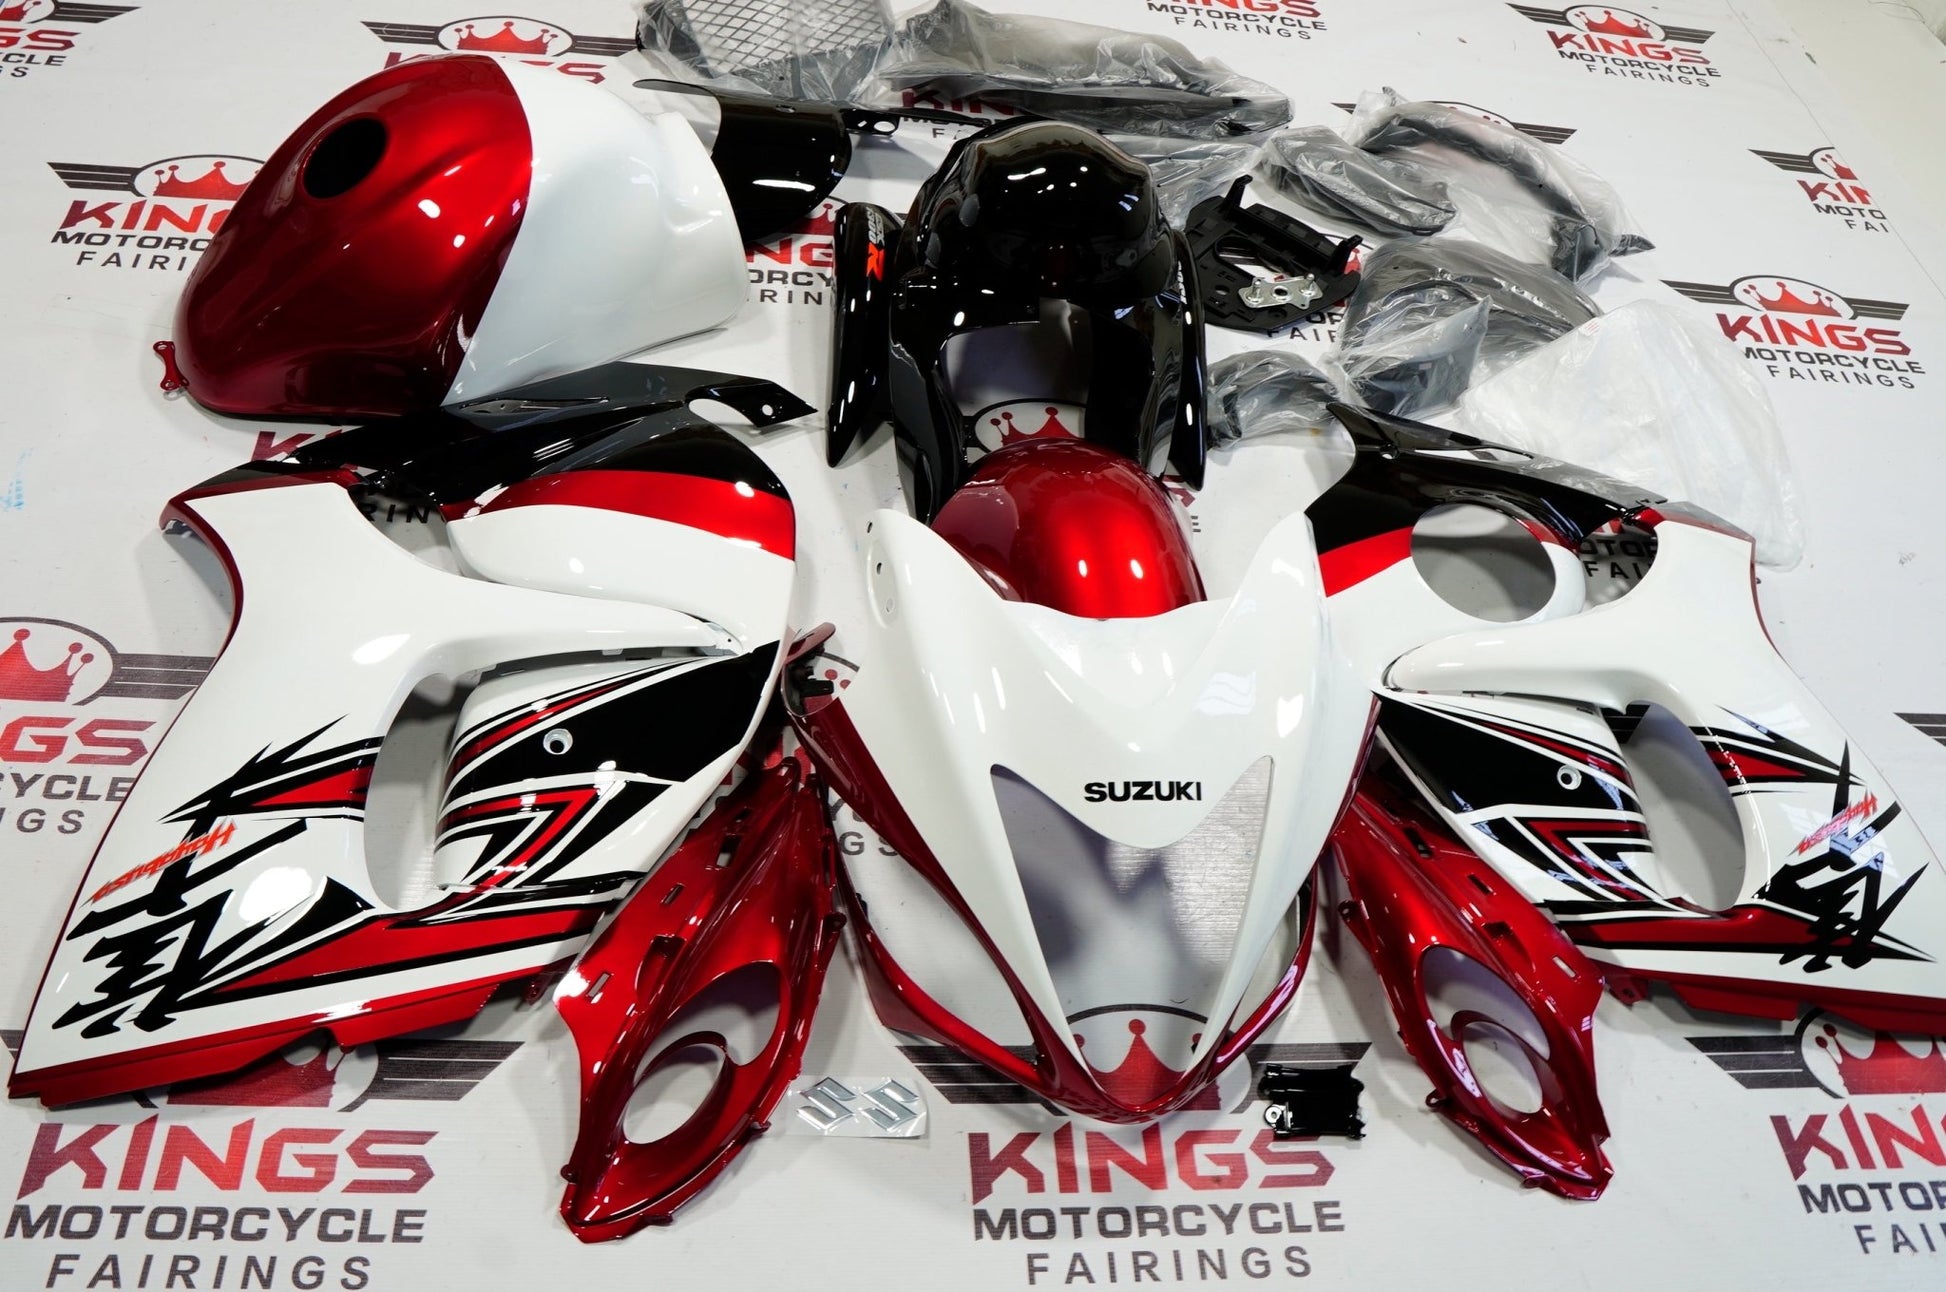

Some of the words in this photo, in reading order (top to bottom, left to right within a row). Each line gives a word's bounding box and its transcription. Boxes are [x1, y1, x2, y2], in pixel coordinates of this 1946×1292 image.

[1147, 3, 1328, 31] MOTORCYCLE
[1174, 16, 1311, 40] FAIRINGS
[0, 52, 67, 66] CLE
[1546, 30, 1711, 65] KINGS
[1558, 50, 1722, 78] MOTORCYCLE
[1586, 64, 1710, 88] FAIRINGS
[1813, 203, 1887, 220] MOTO
[1844, 219, 1889, 233] FAI
[76, 250, 187, 271] FAIRI
[1716, 313, 1912, 356] KINGS
[1766, 364, 1915, 389] FAIRINGS
[0, 772, 137, 802] YCLE
[1084, 780, 1202, 803] SUZUKI
[0, 807, 85, 835] GS
[1769, 1103, 1946, 1181] KIN
[17, 1113, 440, 1201] KINGS
[967, 1121, 1336, 1205] KINGS
[4, 1204, 428, 1243] MOTORCYCLE
[973, 1200, 1345, 1241] MOTORCYCLE
[1854, 1222, 1946, 1255] FAI
[45, 1253, 372, 1291] FAIRINGS
[1026, 1245, 1312, 1285] FAIRINGS
